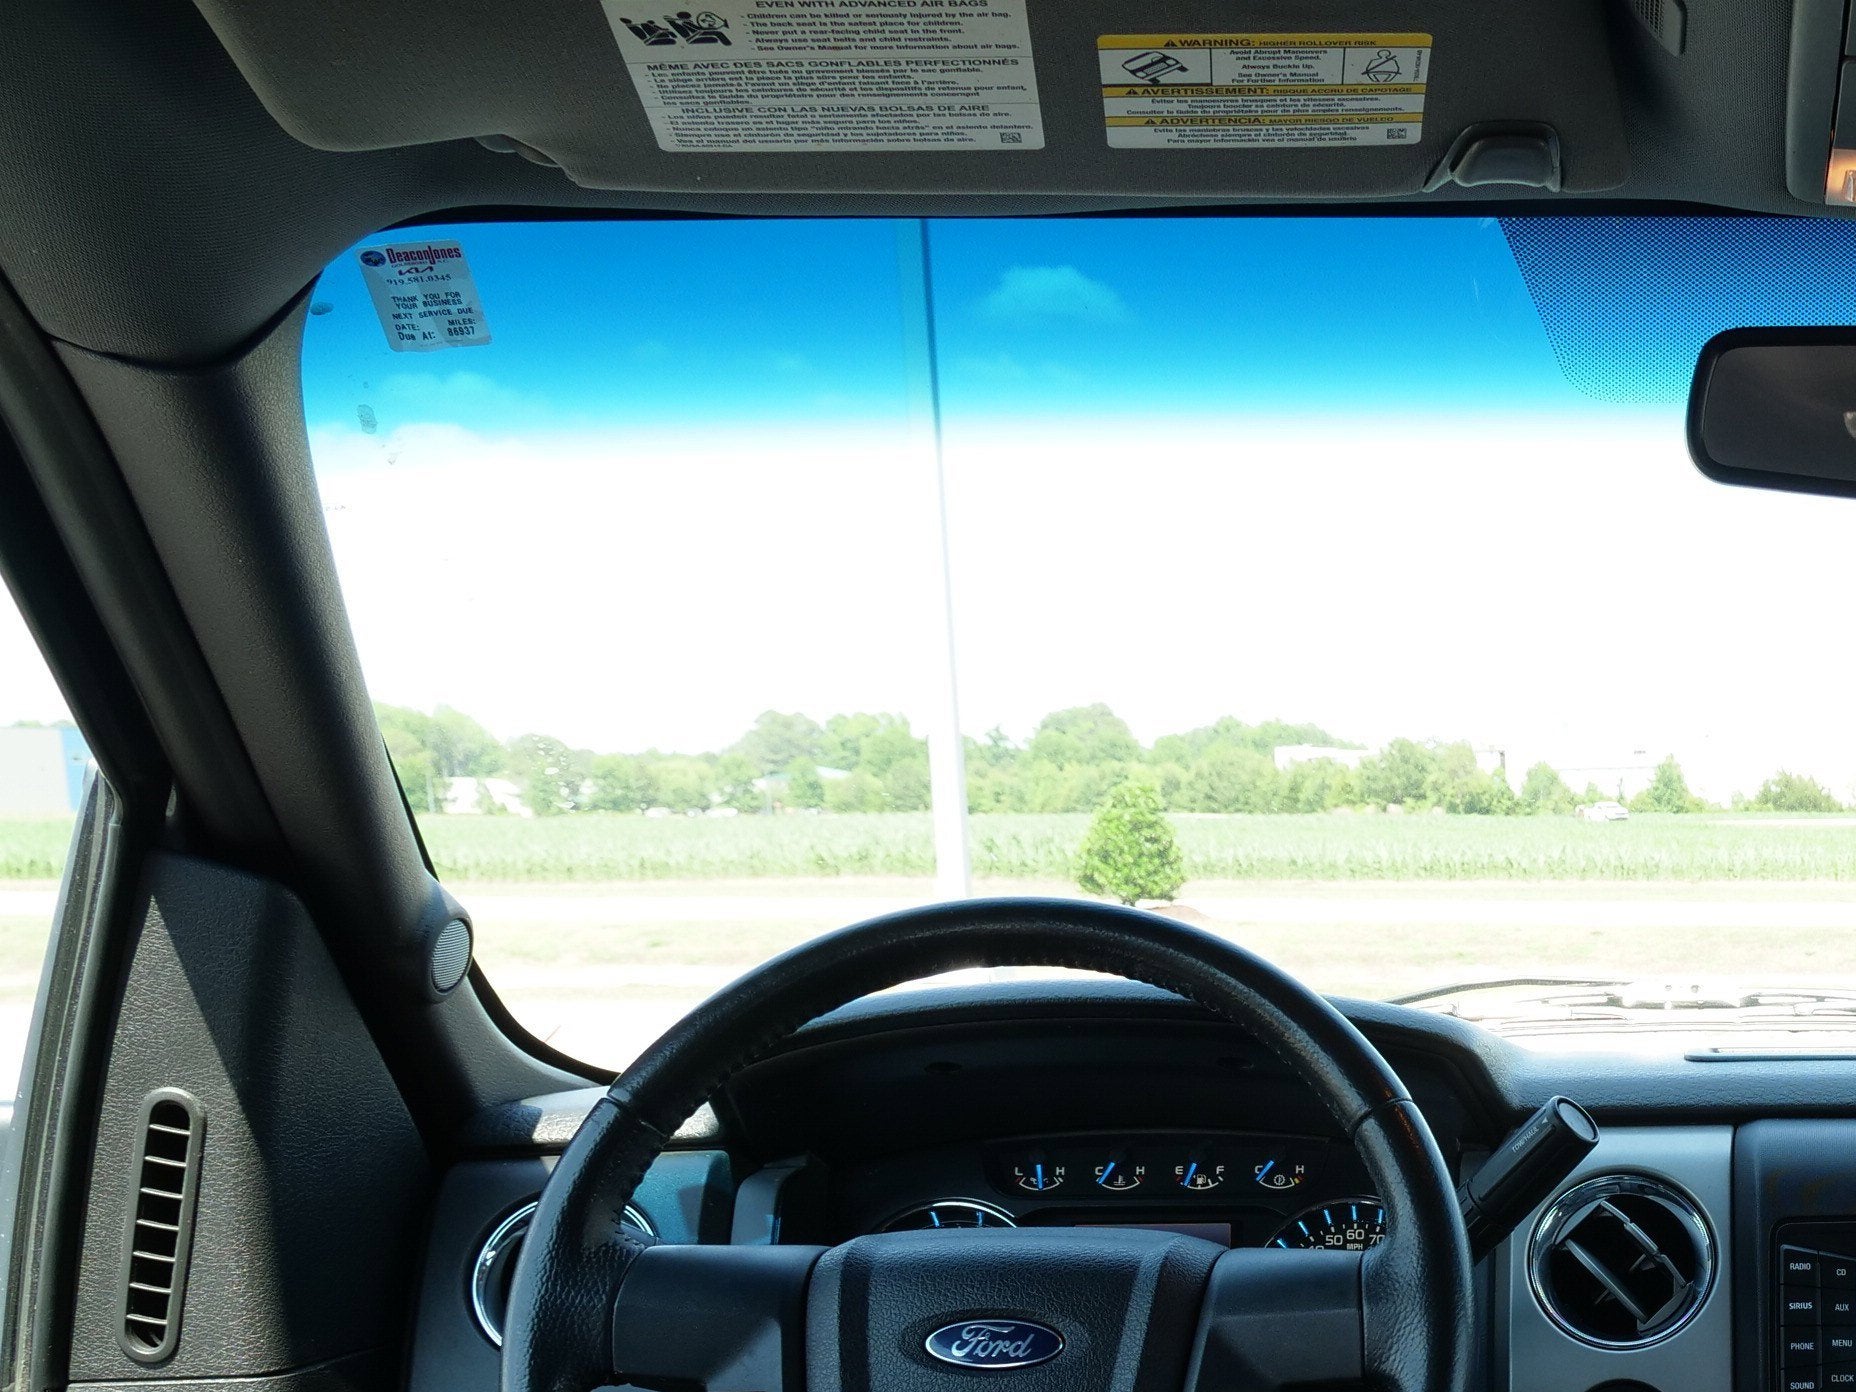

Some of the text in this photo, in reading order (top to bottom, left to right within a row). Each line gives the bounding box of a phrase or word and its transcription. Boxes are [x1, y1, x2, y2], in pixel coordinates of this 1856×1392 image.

[801, 0, 834, 8] WITH
[391, 295, 418, 303] THANK
[445, 291, 461, 299] FOR
[395, 298, 463, 310] YOUR BUSINESS
[392, 306, 474, 320] NEXT SERVICE DUE
[398, 331, 416, 341] Due
[1346, 1229, 1364, 1240] 60
[1325, 1234, 1343, 1246] 50
[1789, 1262, 1811, 1271] RADIO
[1836, 1268, 1847, 1276] CD
[1789, 1302, 1812, 1310] SIRIUS
[951, 1324, 1035, 1357] Ford
[1832, 1339, 1852, 1347] MENU
[1790, 1382, 1815, 1390] SOUND
